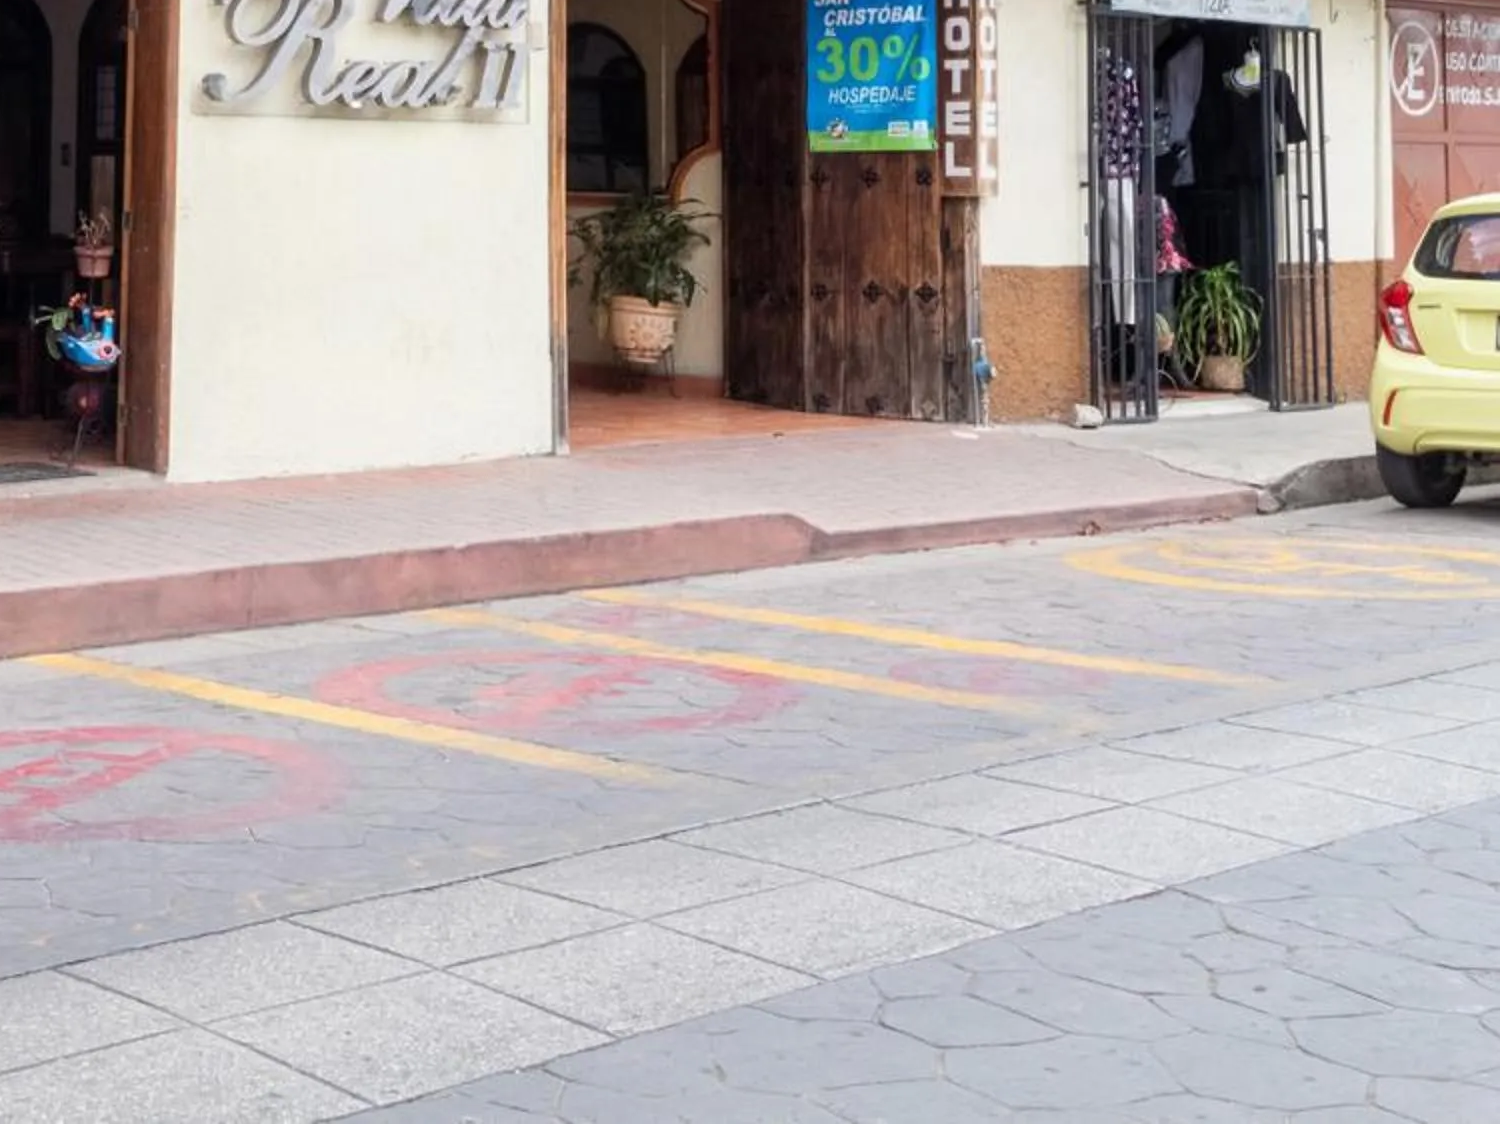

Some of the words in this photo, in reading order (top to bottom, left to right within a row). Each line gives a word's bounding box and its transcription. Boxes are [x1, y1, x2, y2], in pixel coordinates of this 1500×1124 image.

[824, 2, 927, 27] CRISTÓBAL
[816, 33, 931, 83] 30%
[827, 85, 917, 105] HOSPEDAJE
